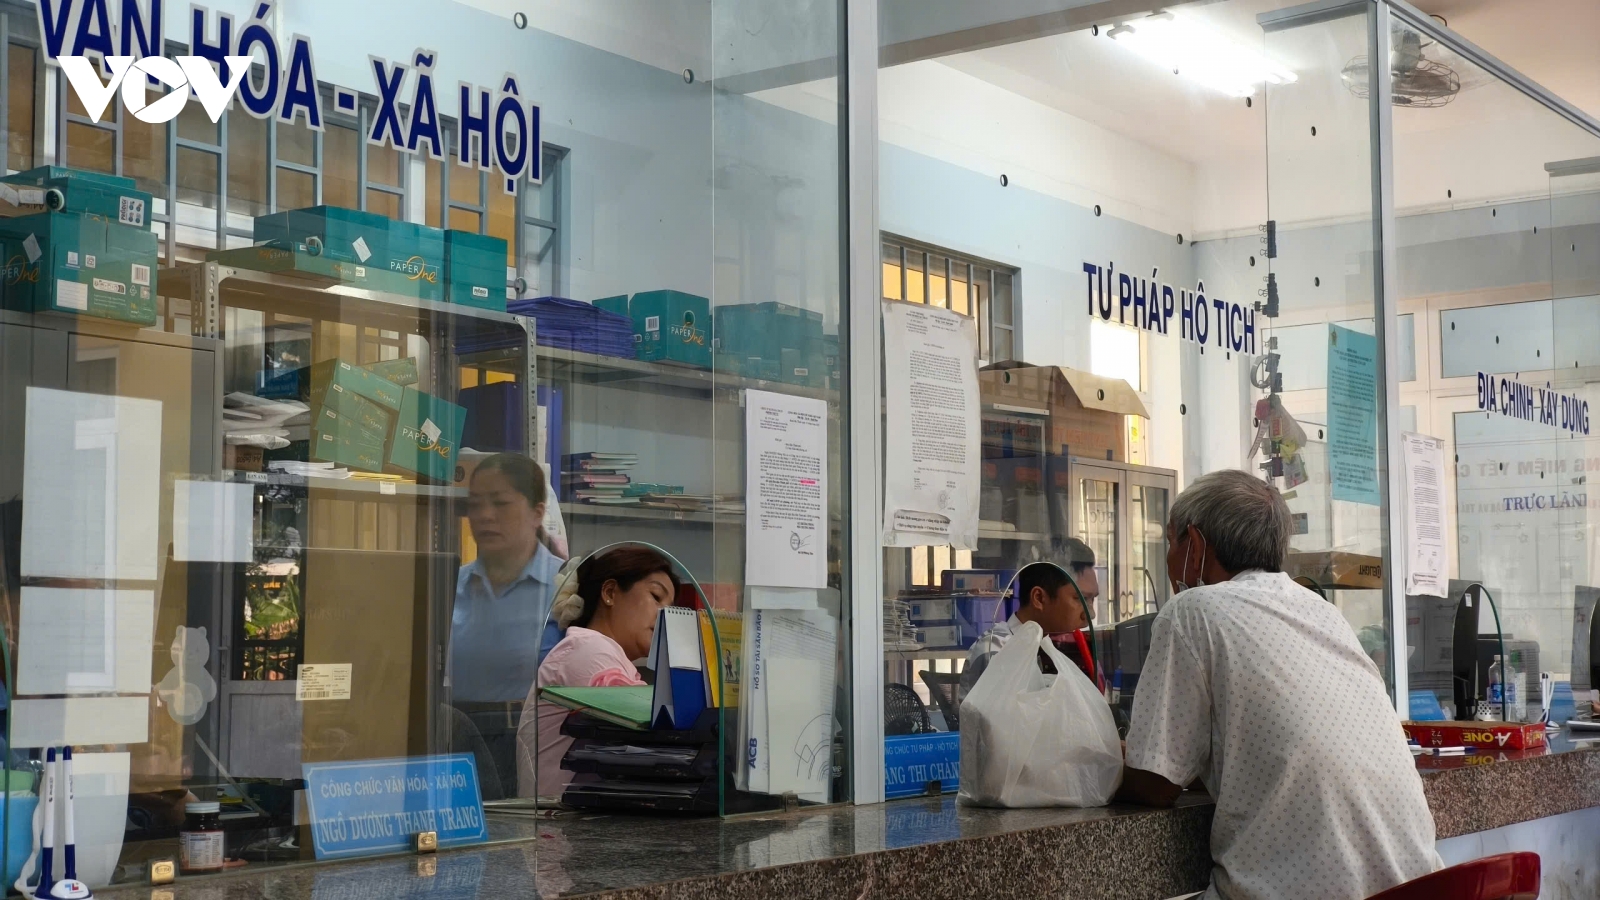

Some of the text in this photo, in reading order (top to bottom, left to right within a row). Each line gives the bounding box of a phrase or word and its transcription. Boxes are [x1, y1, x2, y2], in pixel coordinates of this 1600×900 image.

[192, 2, 321, 127] HÓA
[372, 54, 442, 157] XÃ
[461, 79, 540, 192] HỘI
[0, 267, 20, 279] PER
[390, 261, 419, 274] PAPER
[1083, 261, 1255, 360] TƯ PHÁP HỘ TỊCH
[670, 326, 692, 337] PAPER
[1477, 371, 1590, 439] ĐỊA CHÍNH XÂY DỰNG
[402, 427, 433, 445] PAPER
[1503, 493, 1546, 512] TRỰC
[747, 737, 758, 768] ACB
[930, 757, 960, 781] CHÀN
[321, 779, 351, 798] CÔNG
[354, 776, 383, 794] CHỨC
[385, 775, 405, 793] VĂN
[407, 773, 428, 791] HÓA
[436, 771, 448, 789] XÃ
[450, 770, 467, 792] HỘI
[319, 805, 479, 843] NGÔ DƯƠNG THANH TRANG
